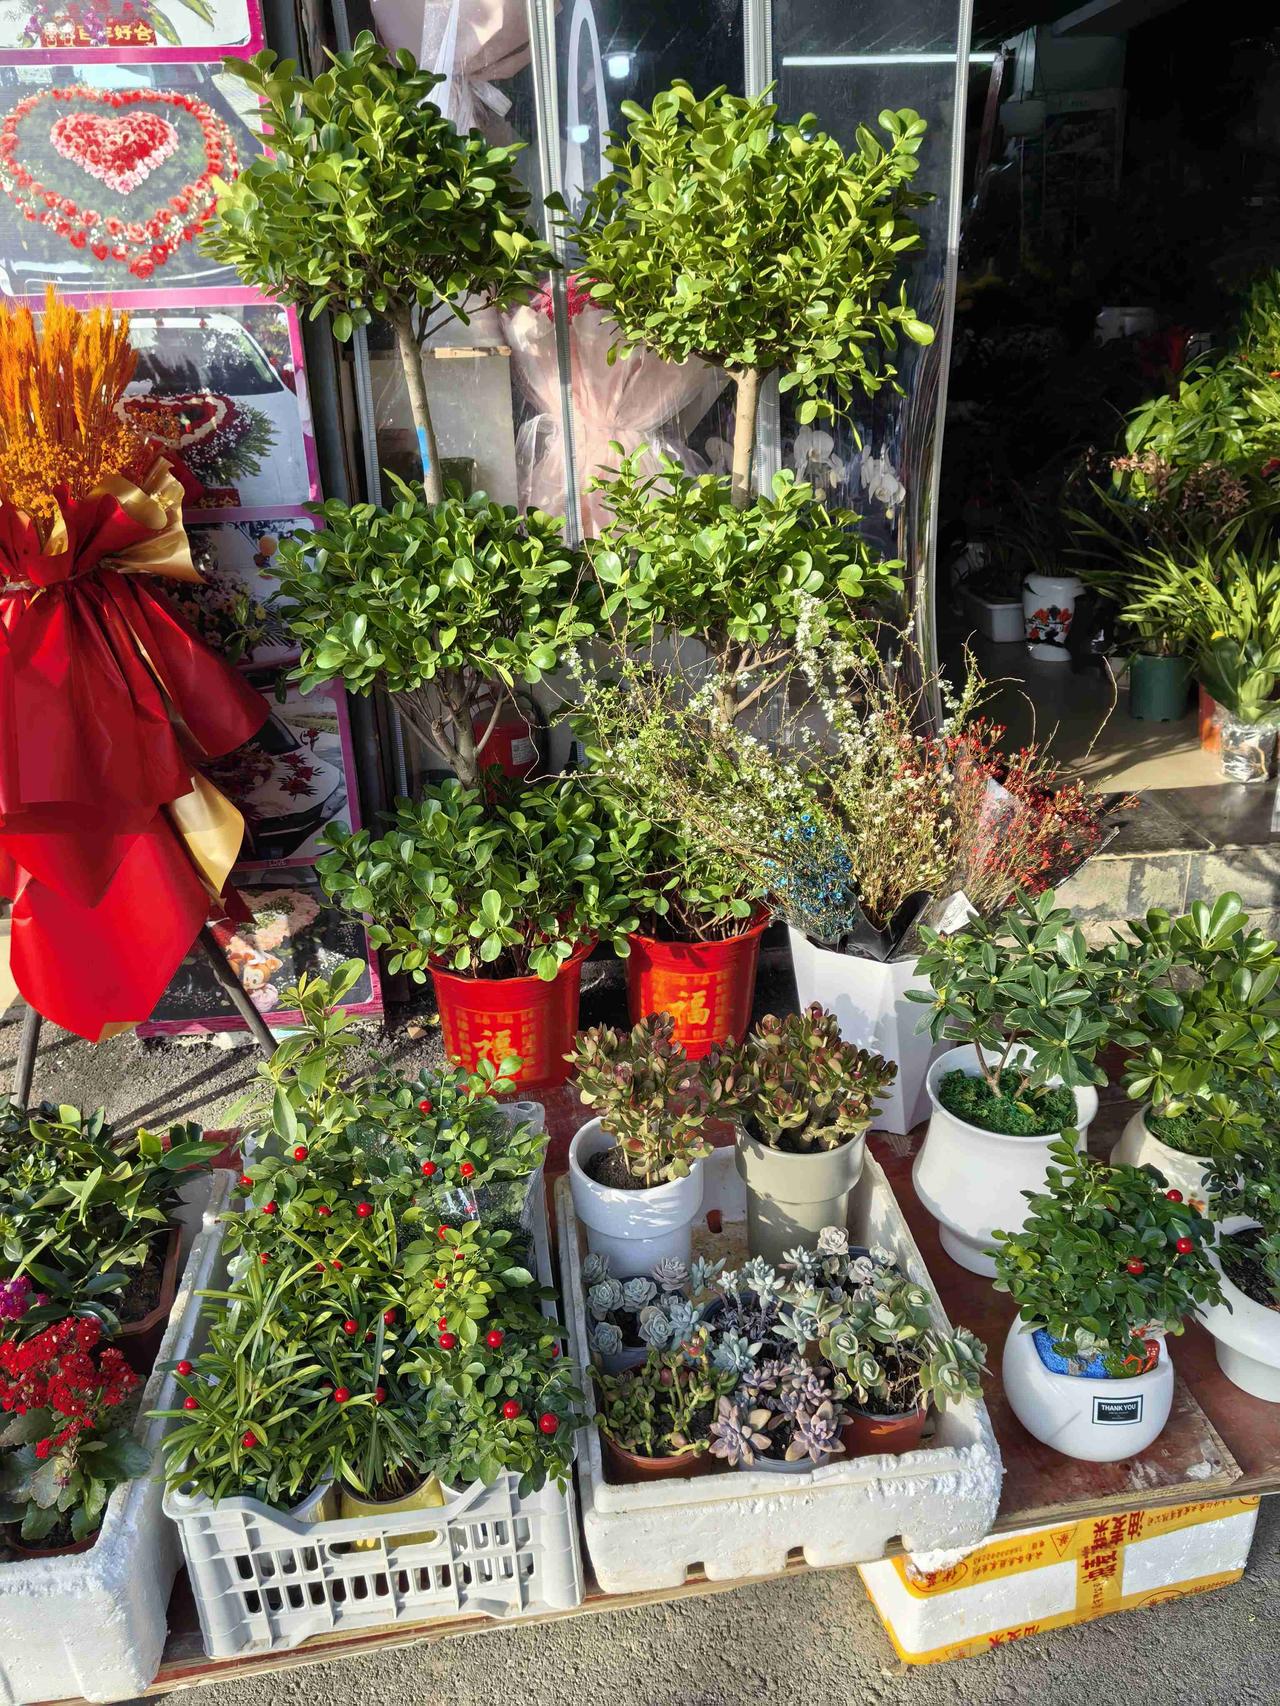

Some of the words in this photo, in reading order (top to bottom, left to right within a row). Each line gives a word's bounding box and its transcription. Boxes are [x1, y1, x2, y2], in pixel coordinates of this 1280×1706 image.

[666, 990, 711, 1026] 福
[472, 1029, 518, 1064] 福
[1091, 1510, 1145, 1553] 油麦菜
